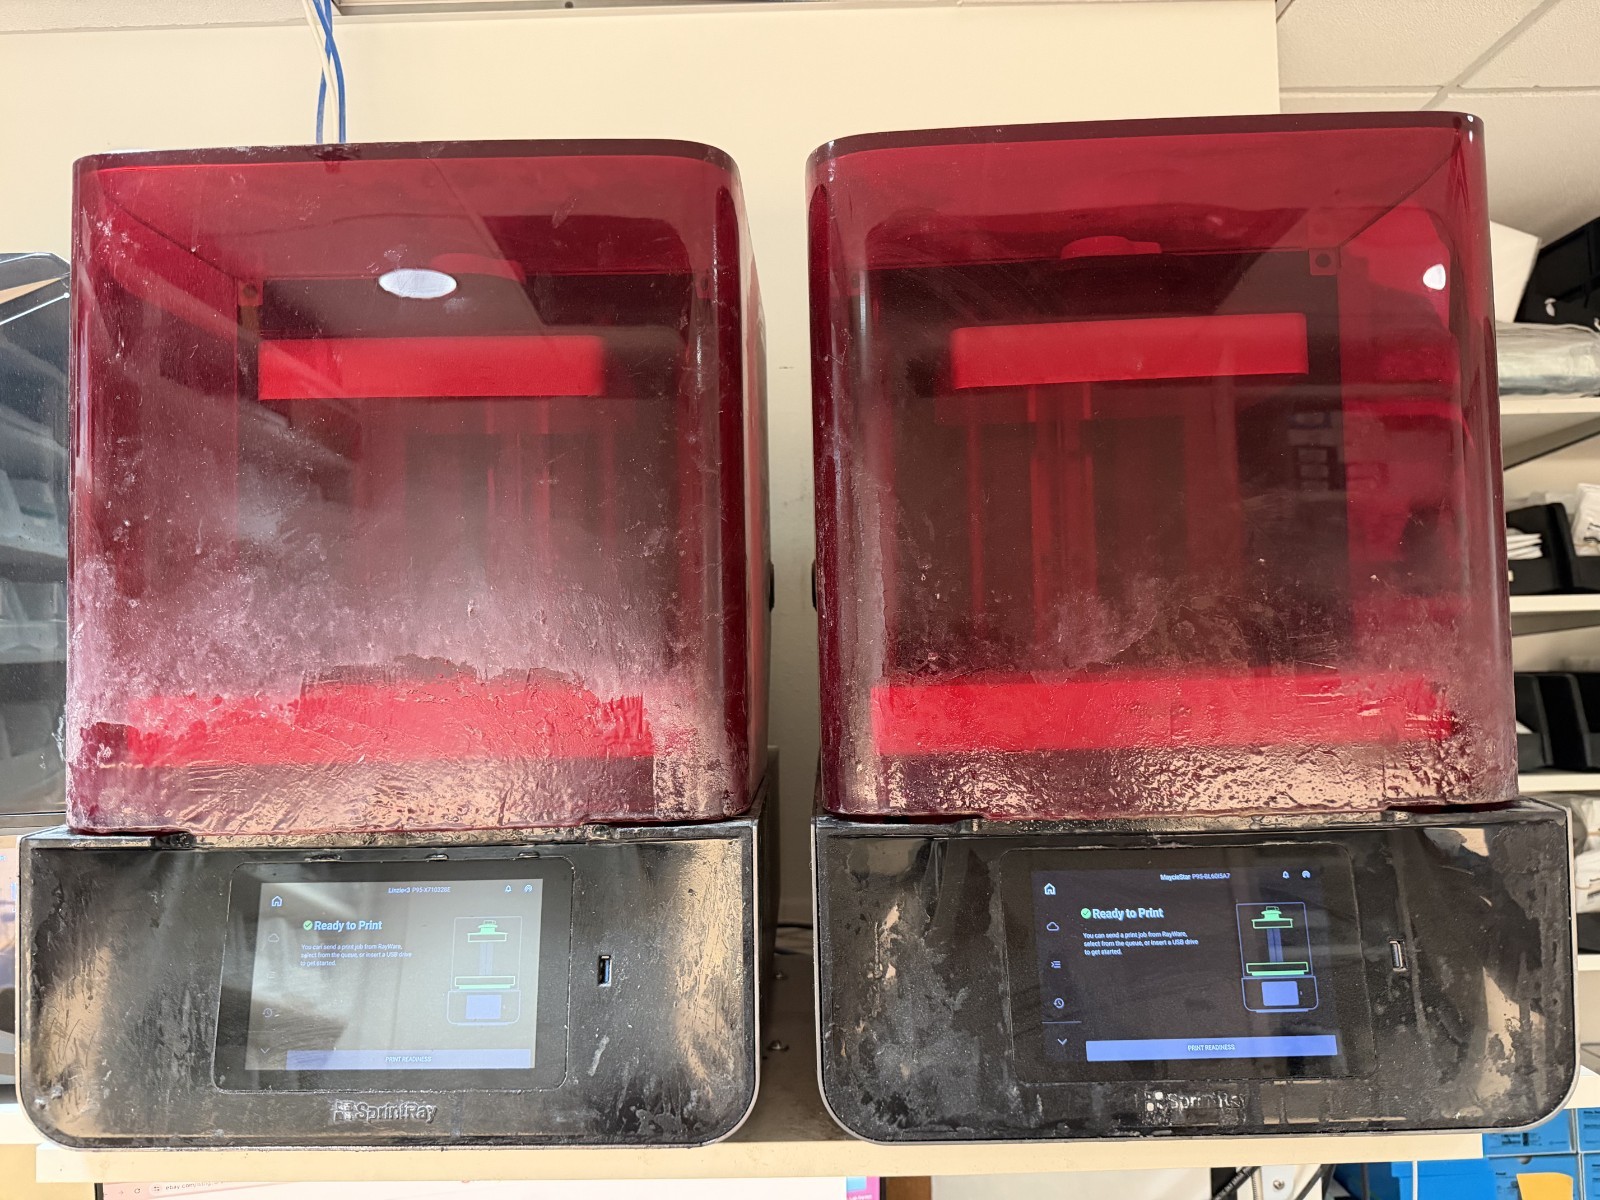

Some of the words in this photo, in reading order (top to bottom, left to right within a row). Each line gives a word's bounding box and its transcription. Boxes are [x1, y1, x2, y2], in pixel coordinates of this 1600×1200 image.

[1092, 908, 1124, 921] Ready
[1125, 908, 1138, 919] to
[1138, 907, 1164, 919] Print
[314, 920, 344, 932] Ready
[346, 921, 356, 930] to
[358, 920, 382, 930] Print
[356, 1102, 438, 1124] SprintRay
